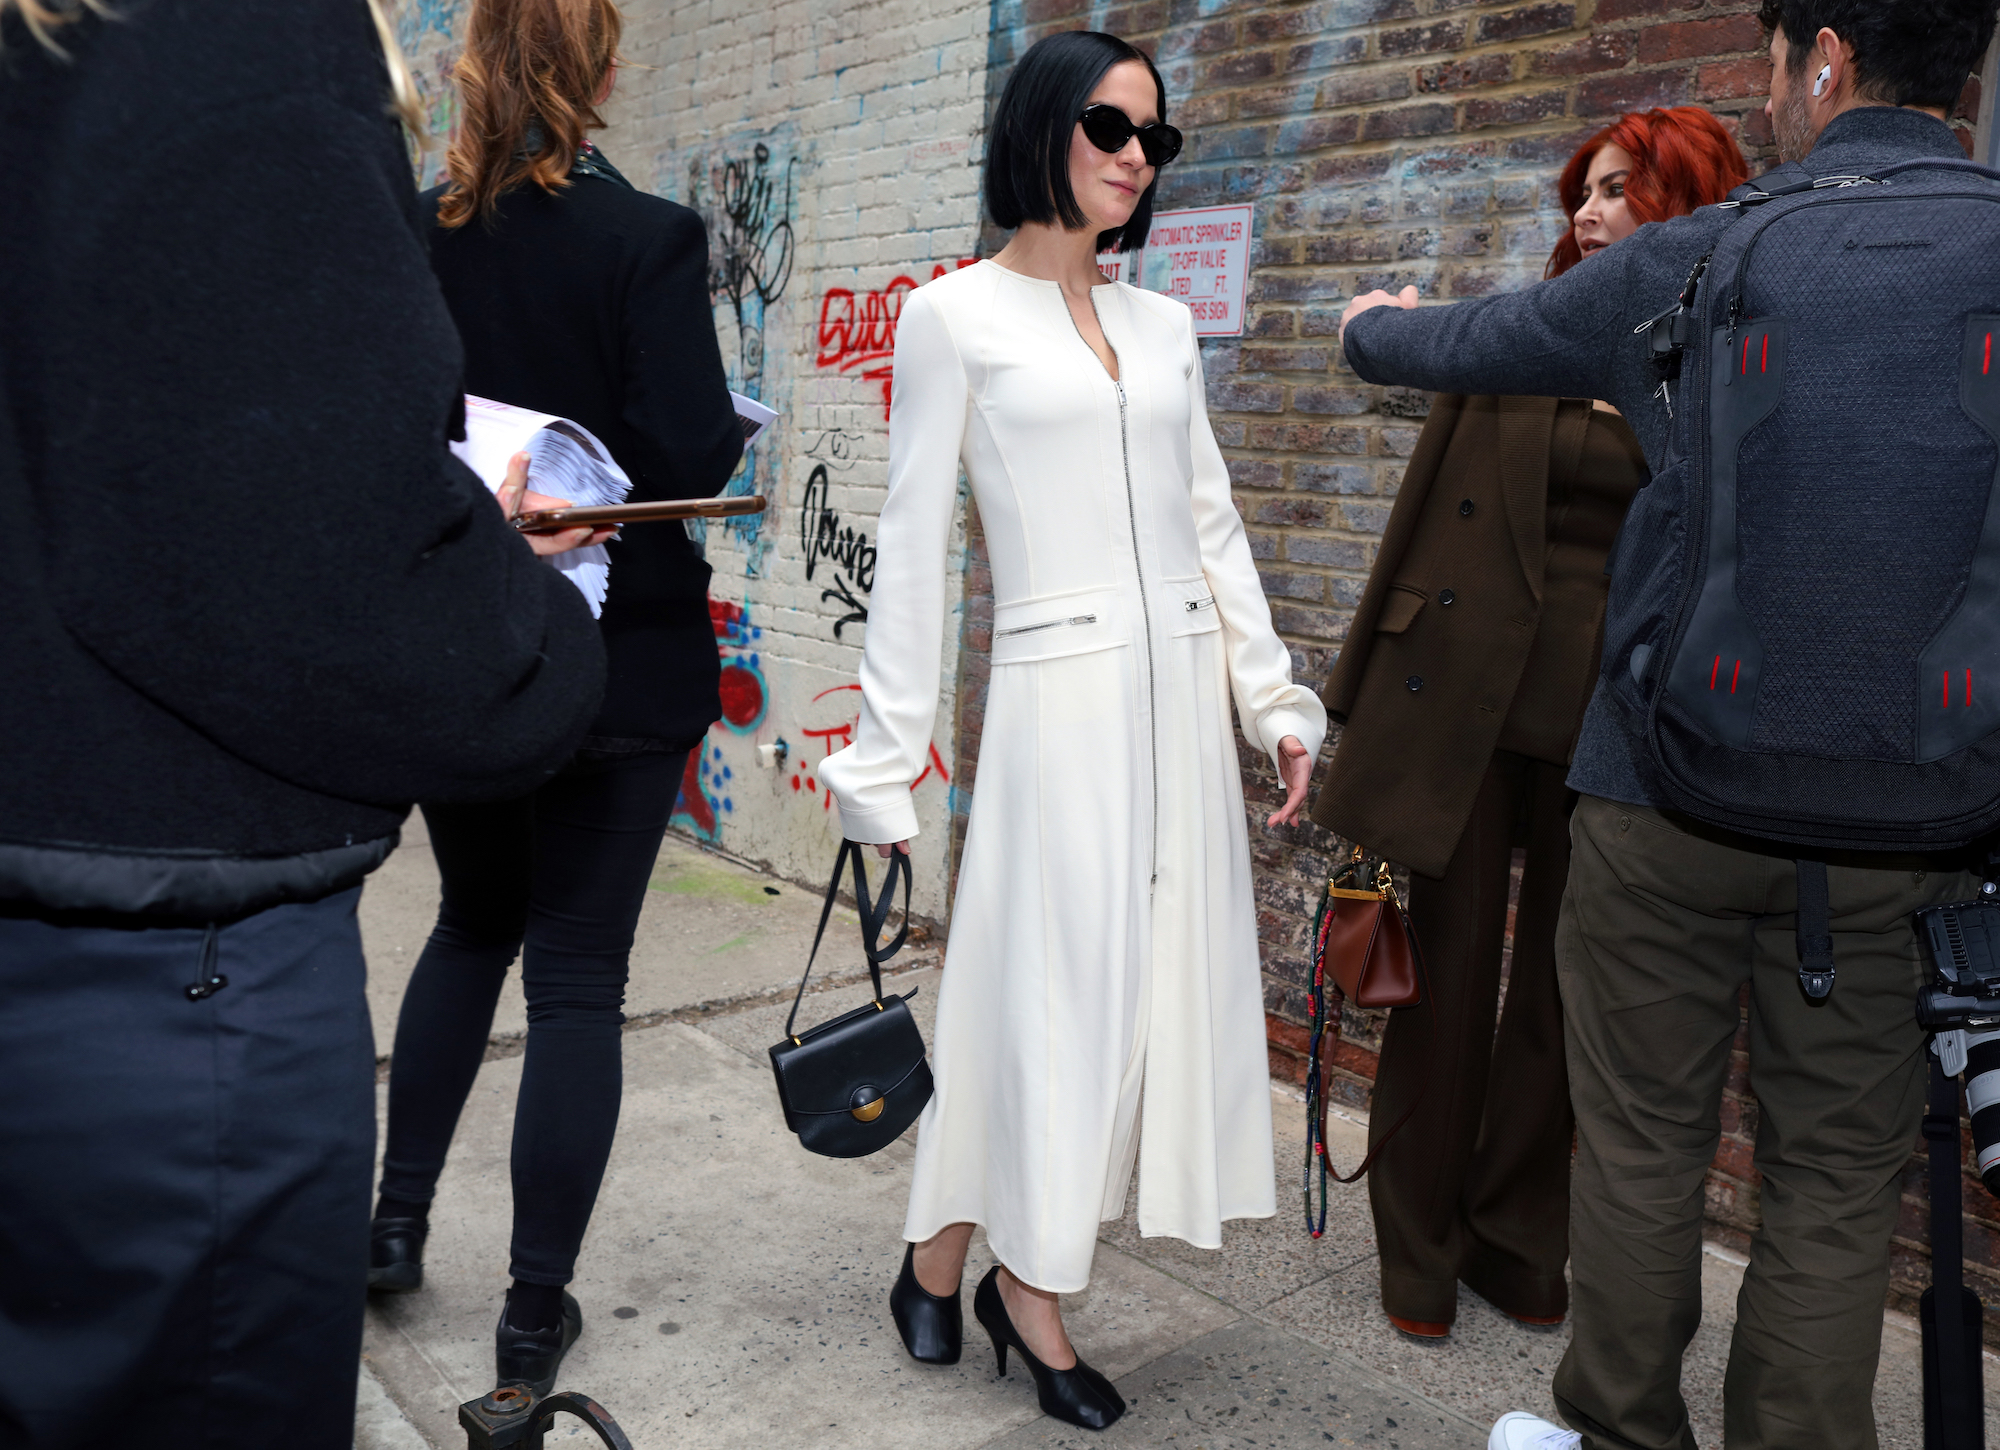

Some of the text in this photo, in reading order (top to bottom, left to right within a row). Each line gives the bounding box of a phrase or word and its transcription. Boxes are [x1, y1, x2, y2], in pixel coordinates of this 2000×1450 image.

[1149, 222, 1242, 247] AUTOMATIC SPRINKLER
[1168, 249, 1226, 271] UT-OFF VALVE
[1214, 275, 1227, 293] FT.
[1189, 301, 1229, 320] THIS SIGN
